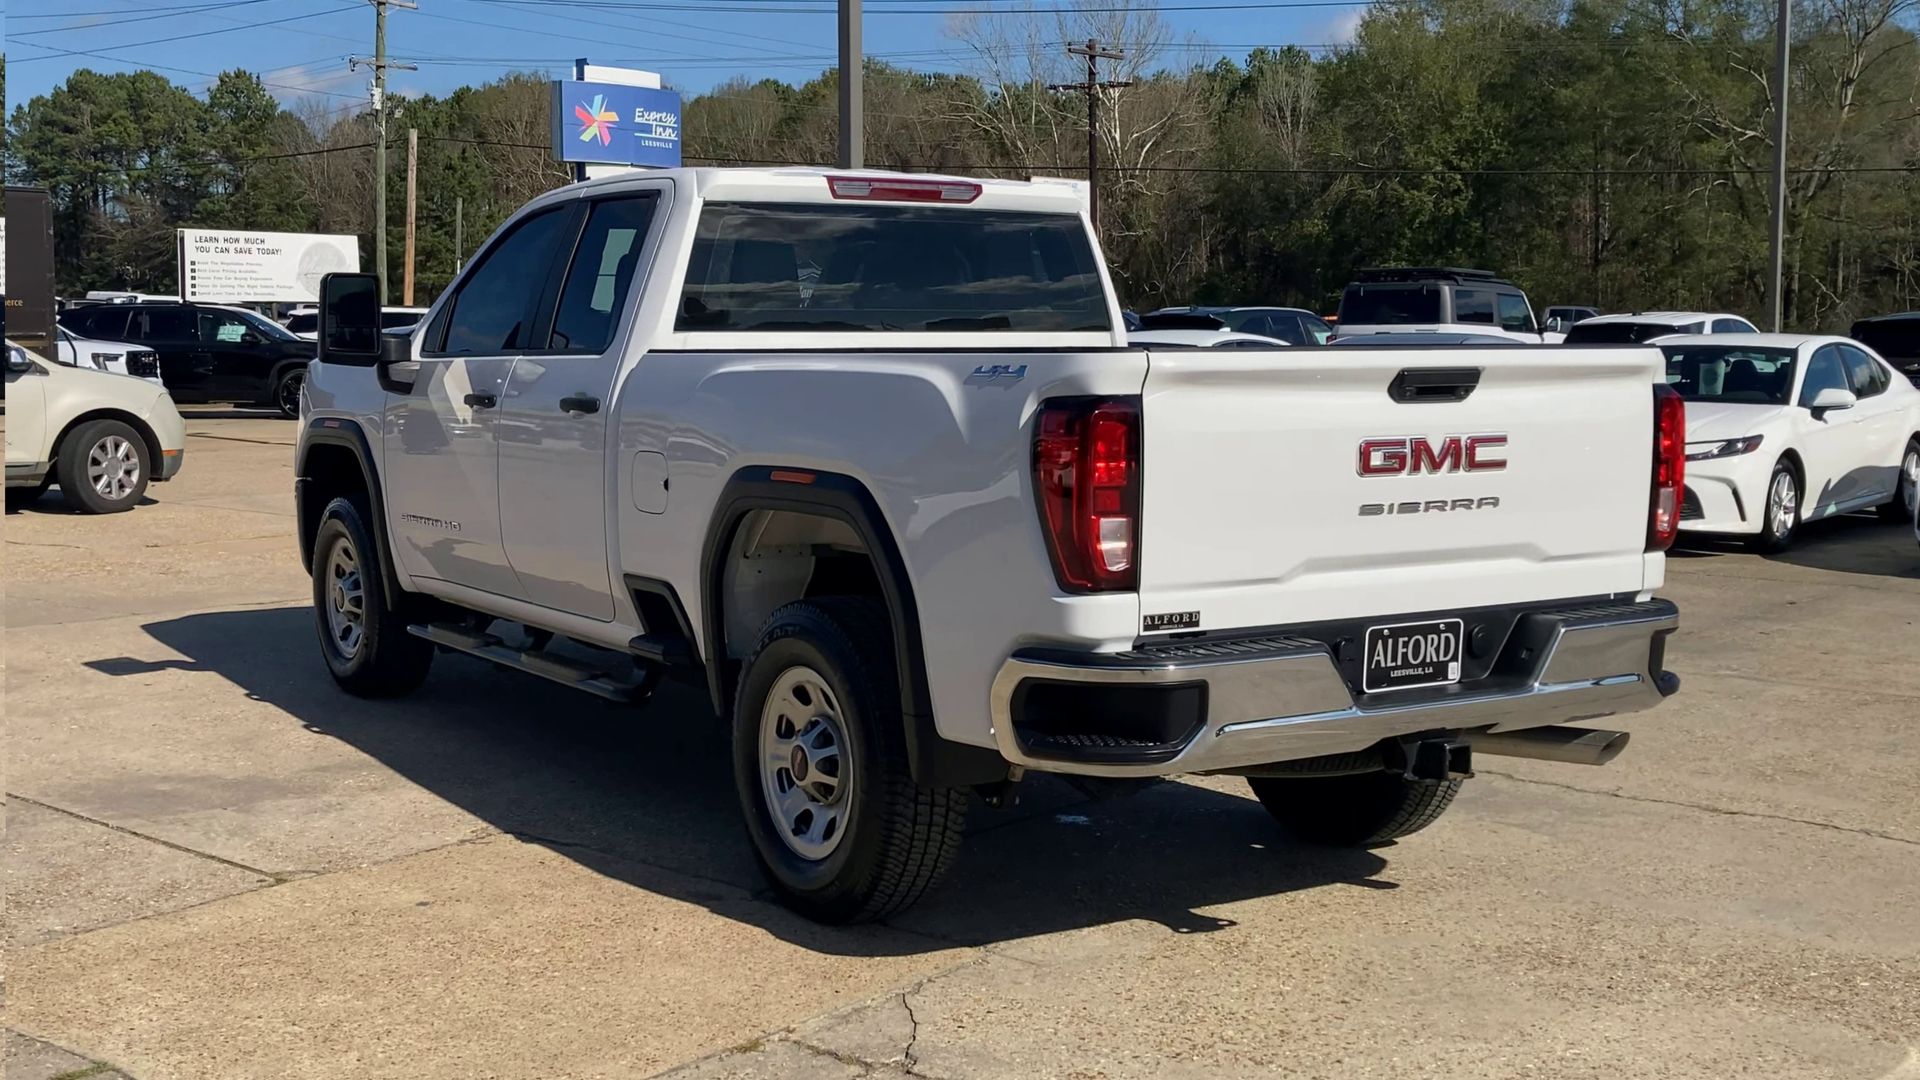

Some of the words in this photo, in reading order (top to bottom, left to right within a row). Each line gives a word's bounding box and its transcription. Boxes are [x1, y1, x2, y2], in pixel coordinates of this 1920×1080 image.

[634, 107, 678, 124] Express
[652, 122, 677, 137] Inn
[194, 236, 219, 244] LEARN
[214, 246, 230, 254] CAN
[233, 247, 253, 255] SAVE
[256, 248, 282, 256] TODAY!
[1356, 433, 1508, 478] GMC
[1358, 496, 1500, 516] SIERRA
[1144, 612, 1199, 625] ALFORD
[1371, 633, 1455, 669] ALFORD
[1390, 667, 1424, 677] LEESVILLE,
